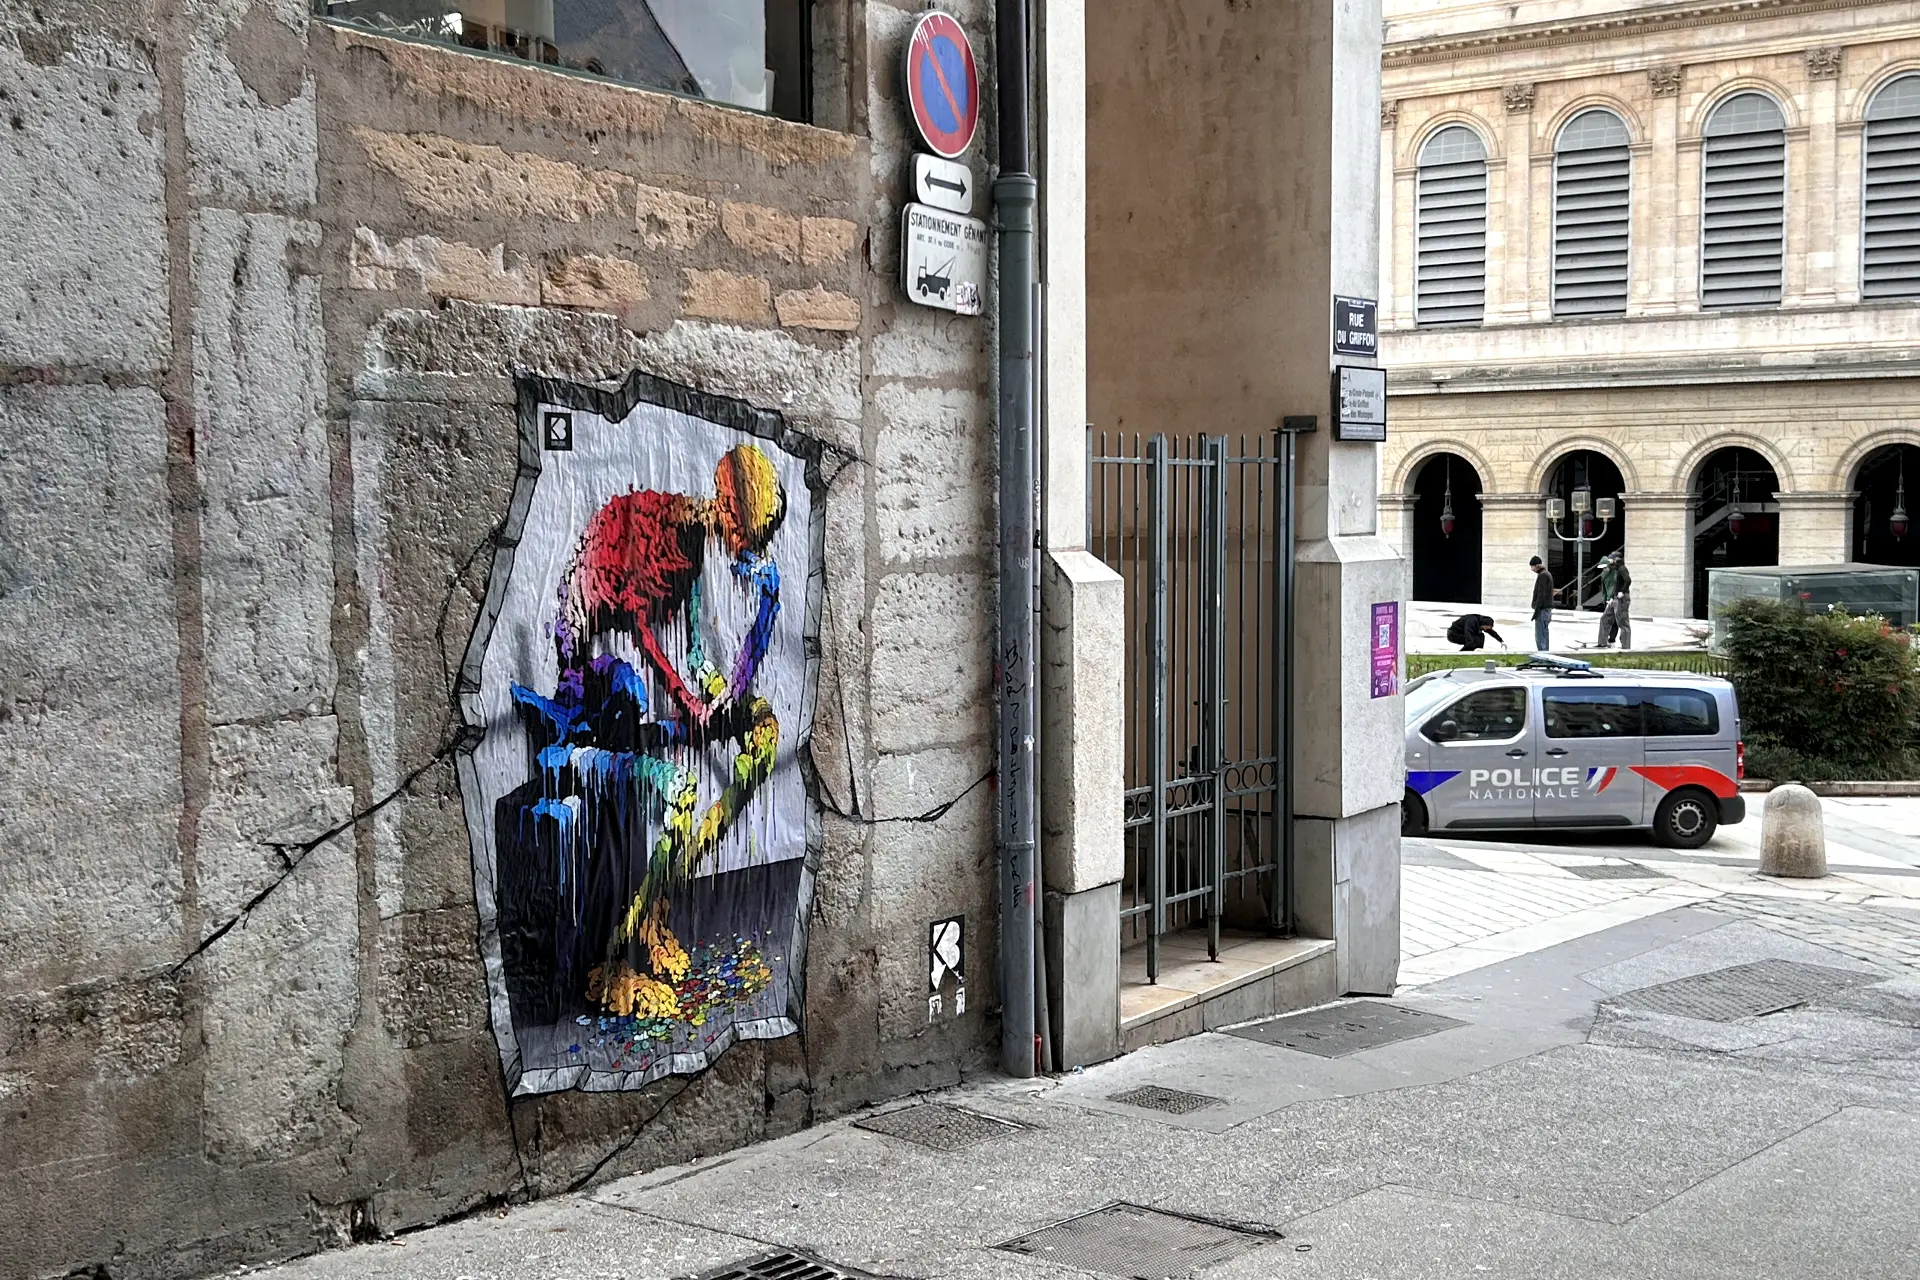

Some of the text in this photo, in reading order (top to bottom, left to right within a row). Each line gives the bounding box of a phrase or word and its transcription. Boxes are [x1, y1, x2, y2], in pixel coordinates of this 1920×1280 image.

[910, 212, 962, 237] STATIONNEMENT
[1349, 312, 1365, 328] RUE
[1337, 330, 1375, 347] DU GRIFFON
[1469, 767, 1580, 787] POLICE
[1469, 787, 1580, 799] NATIONALE
